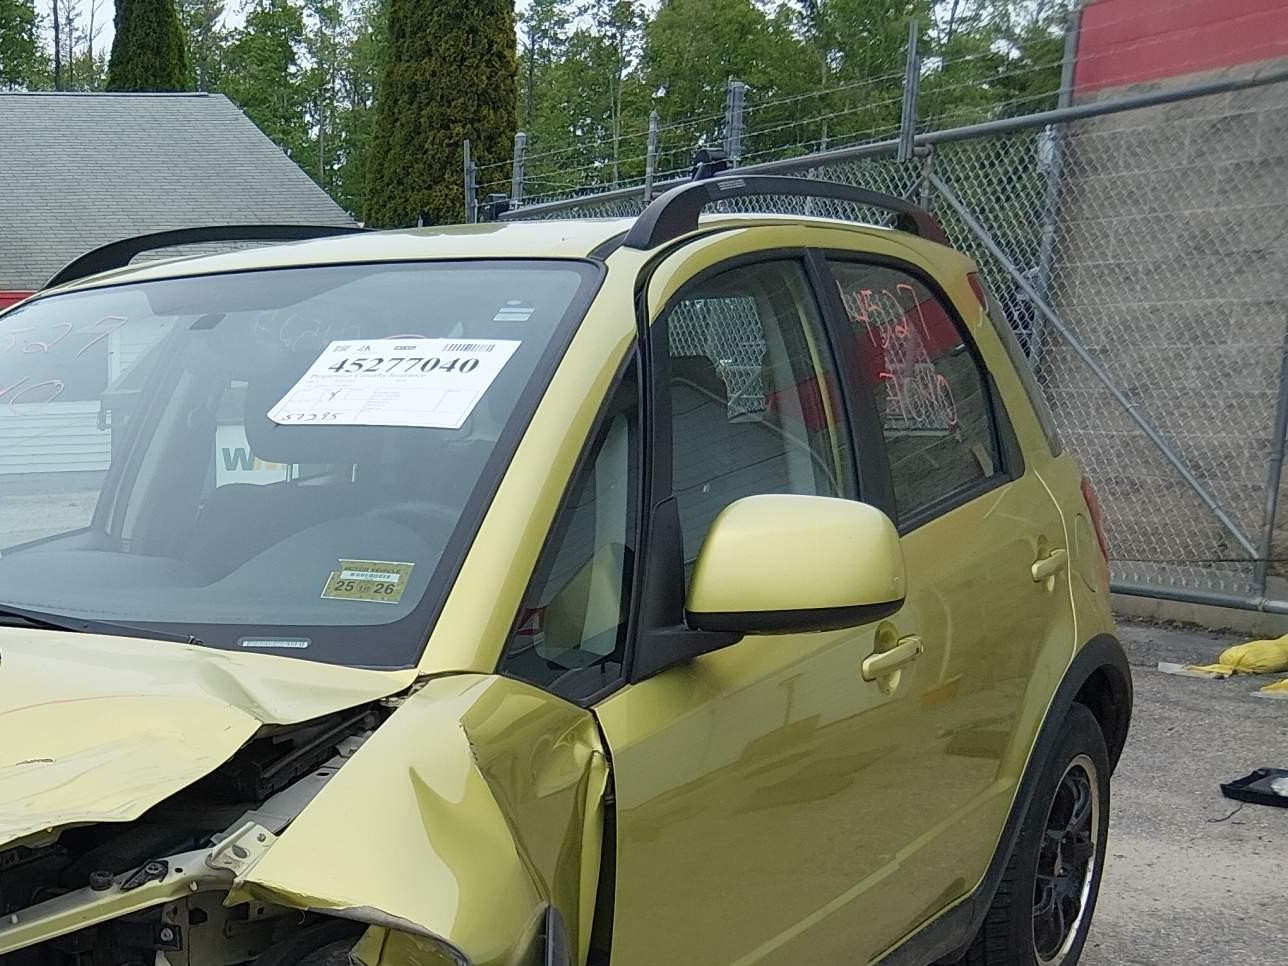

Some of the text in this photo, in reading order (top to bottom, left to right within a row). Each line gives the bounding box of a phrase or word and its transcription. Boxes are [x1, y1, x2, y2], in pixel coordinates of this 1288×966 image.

[327, 356, 480, 374] 45277040
[334, 580, 356, 592] 25
[373, 582, 396, 595] 26
